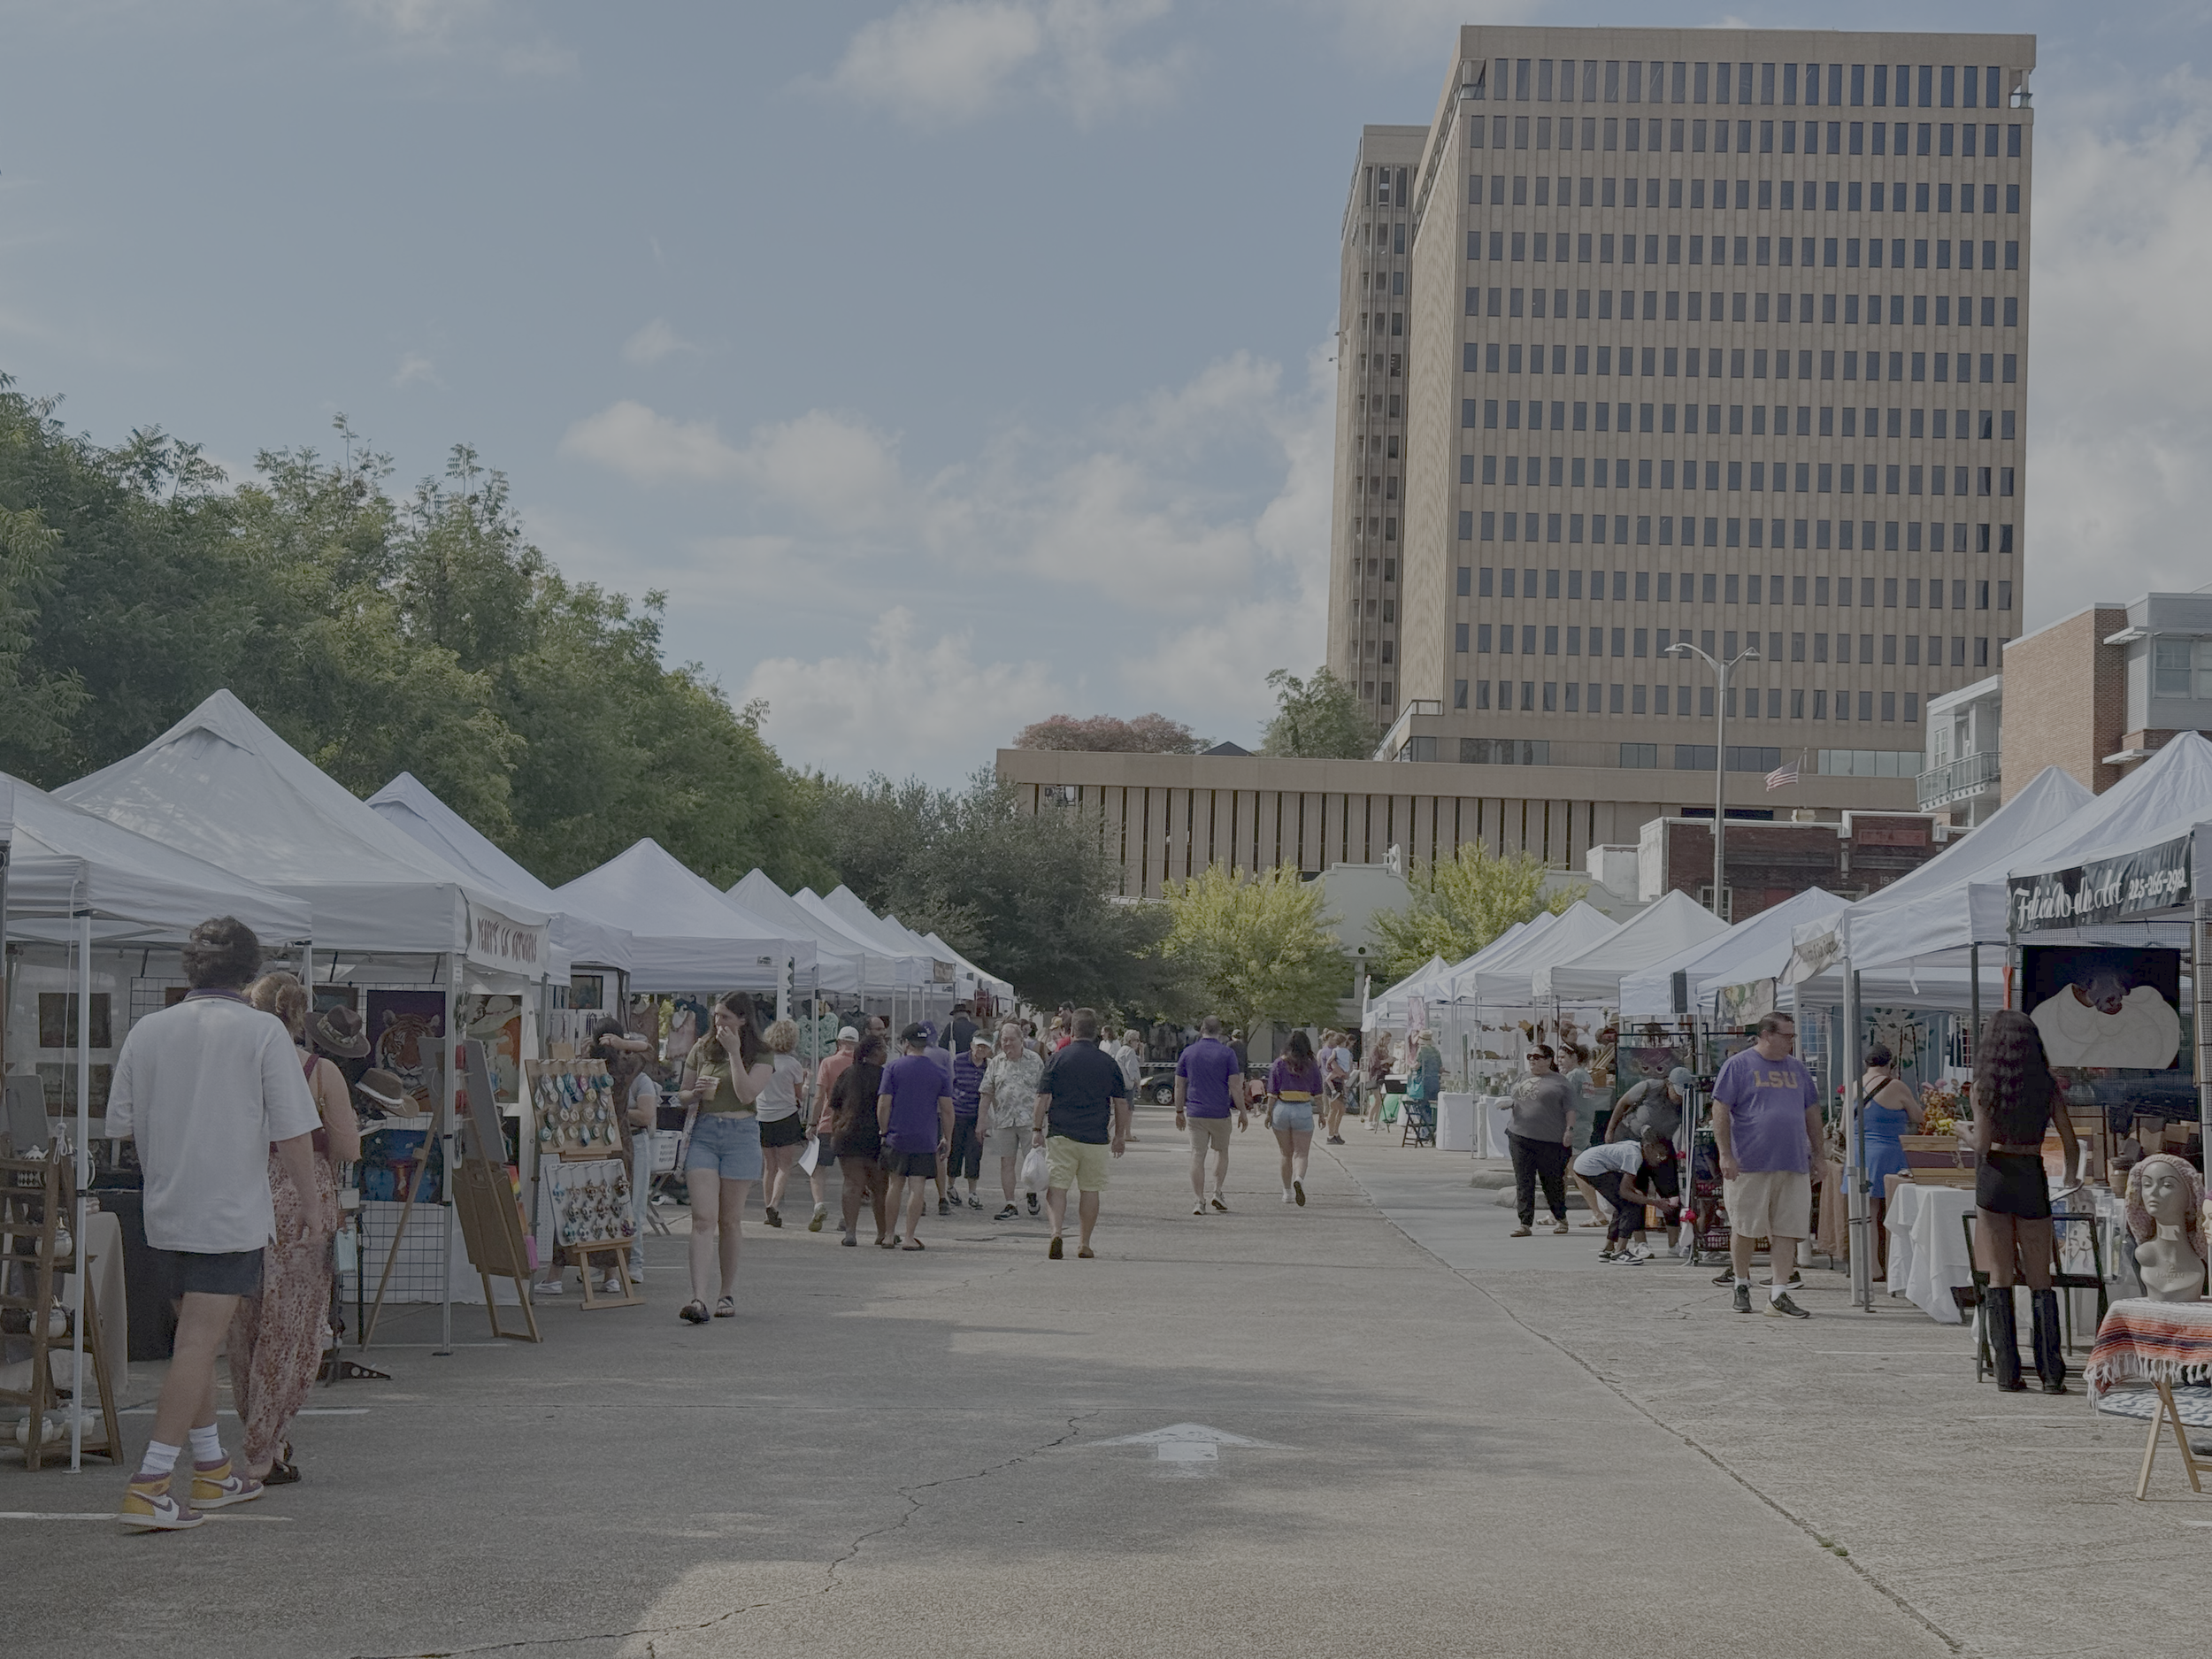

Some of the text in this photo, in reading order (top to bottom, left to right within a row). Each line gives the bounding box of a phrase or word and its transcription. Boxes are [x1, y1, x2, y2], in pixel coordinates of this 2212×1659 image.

[1879, 875, 1896, 885] 192
[2012, 887, 2055, 930] Felicia
[2094, 869, 2124, 910] Art
[1754, 1071, 1798, 1089] LSU
